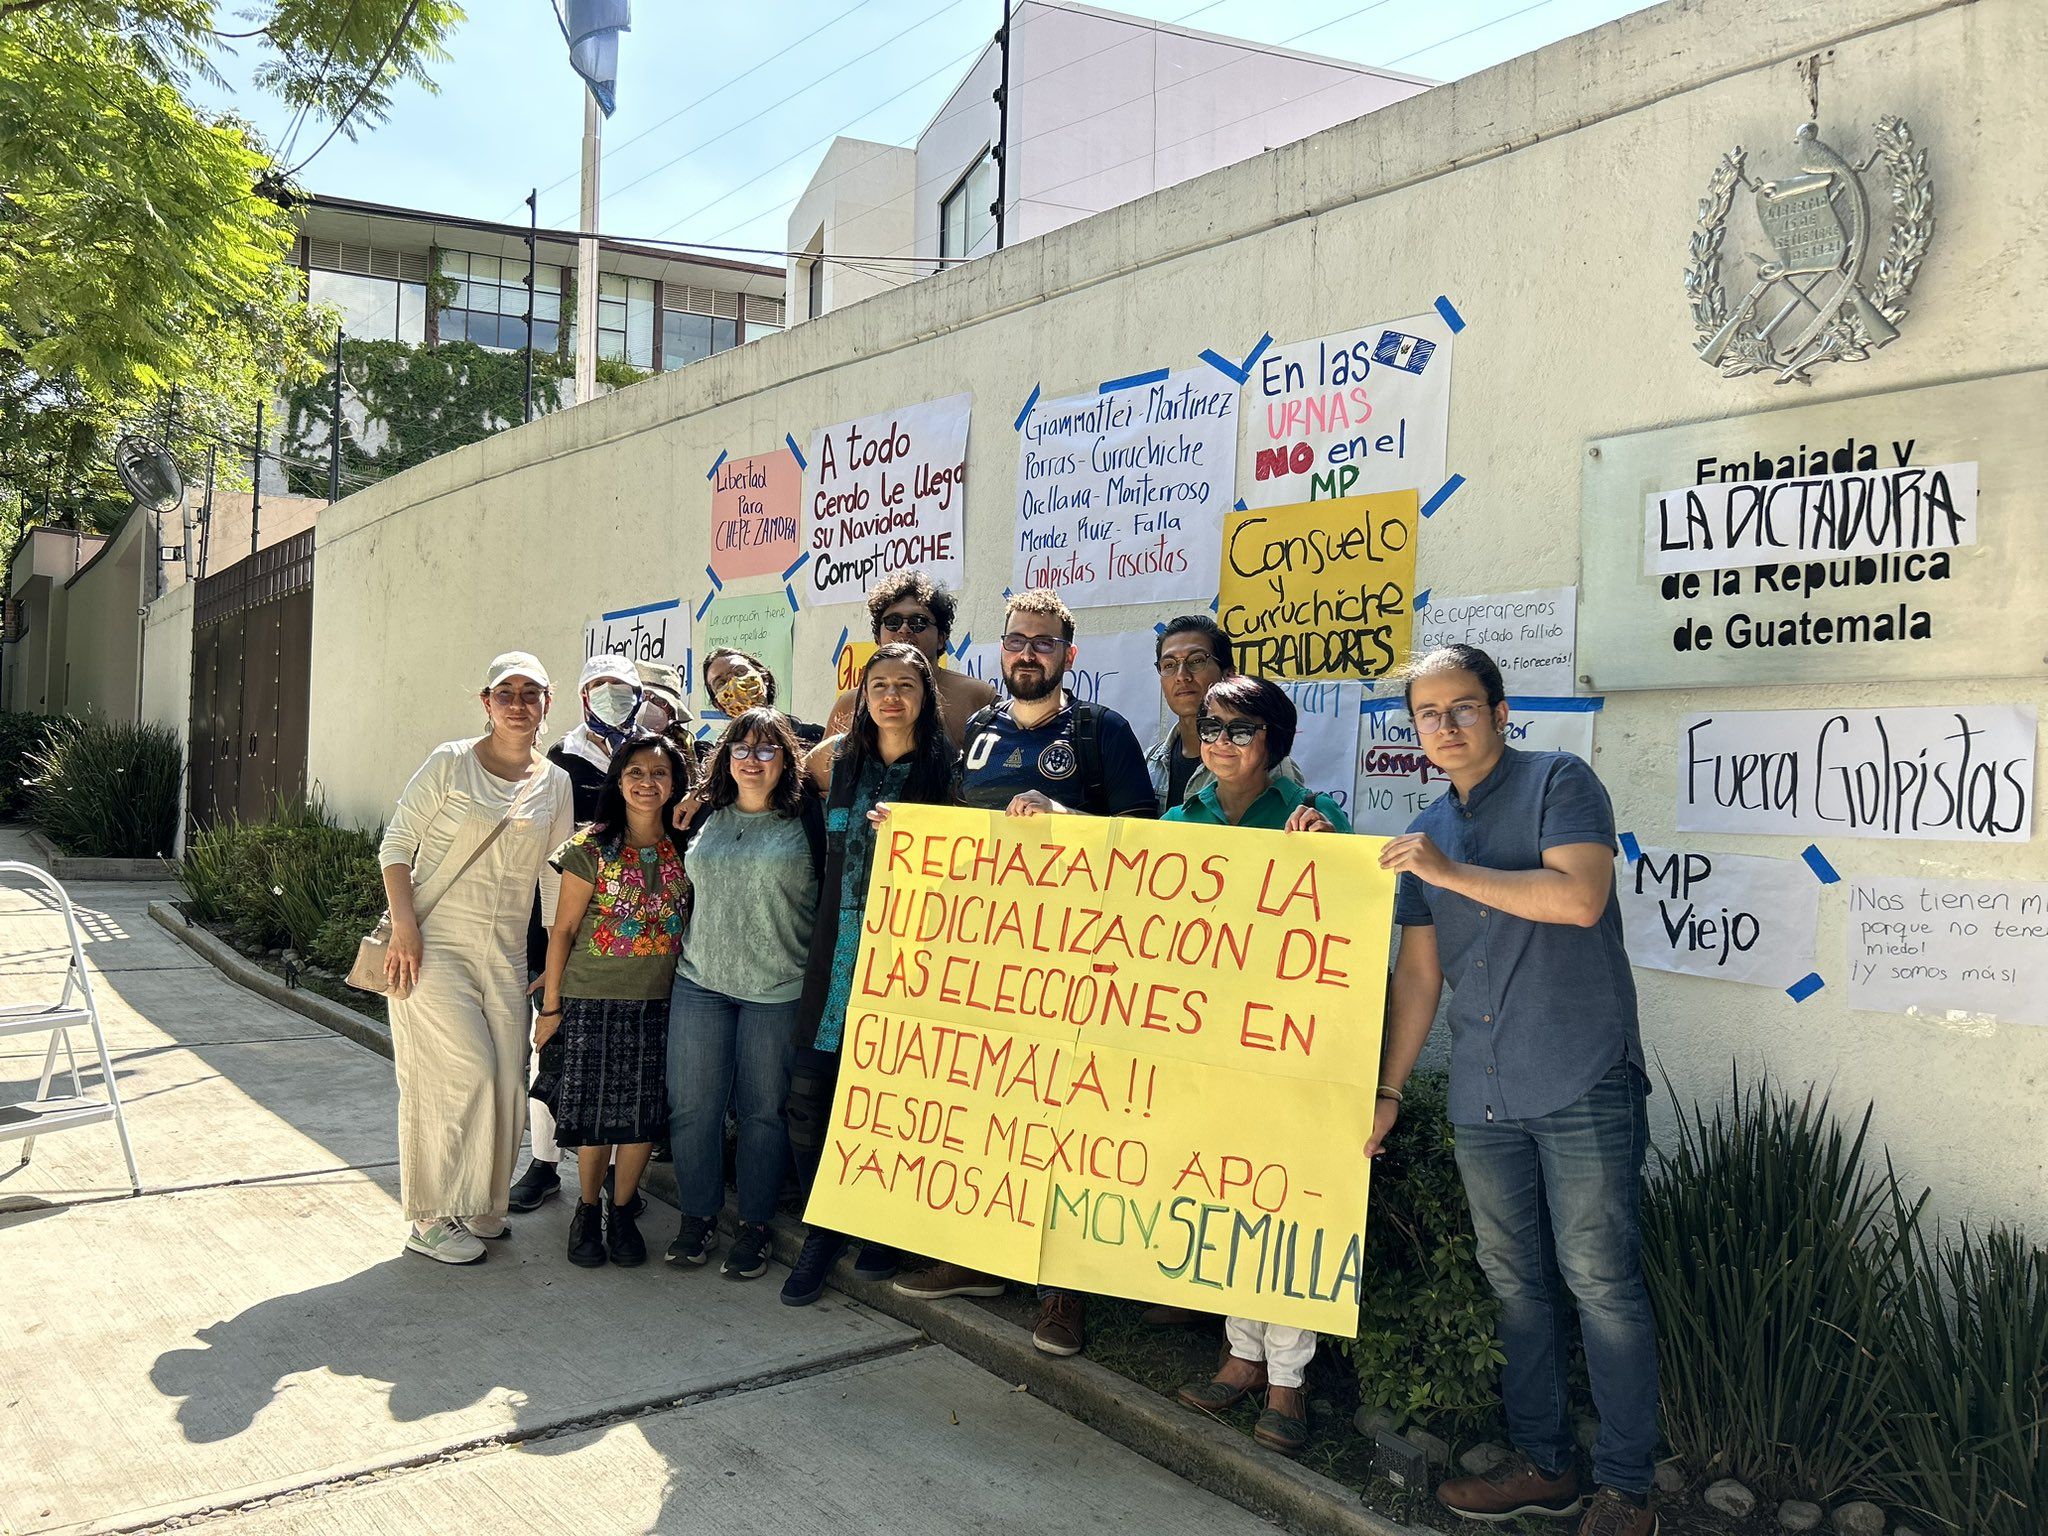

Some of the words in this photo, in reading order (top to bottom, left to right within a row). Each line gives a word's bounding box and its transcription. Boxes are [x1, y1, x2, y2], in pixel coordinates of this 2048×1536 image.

[1262, 355, 1304, 396] En
[1320, 340, 1371, 386] las
[1267, 387, 1373, 440] URNAS
[820, 433, 837, 485] A
[847, 421, 911, 471] todo
[1255, 442, 1315, 482] NO
[1328, 435, 1367, 464] en
[1375, 418, 1406, 459] el
[715, 460, 767, 492] Libertad
[814, 483, 869, 521] Cerdo
[881, 472, 905, 507] le
[914, 462, 966, 510] llega
[1310, 465, 1360, 502] MP
[738, 495, 764, 517] Para
[813, 527, 834, 549] su
[840, 503, 919, 548] Navidad,
[1134, 511, 1182, 535] Falla
[1660, 490, 1713, 551] LA
[1726, 469, 1966, 551] DICTADURA
[716, 518, 750, 551] CHEPE
[753, 516, 796, 546] ZAMORA
[1025, 551, 1096, 589] Golpistas
[1108, 534, 1188, 580] Fascistas
[1661, 573, 1700, 600] de
[1713, 569, 1740, 596] la
[1422, 601, 1556, 625] Recuperaremos
[1673, 617, 1712, 651] de
[1726, 604, 1932, 649] Guatemala
[1232, 625, 1395, 679] TRAIDORES
[1423, 631, 1455, 647] este
[1465, 628, 1514, 646] Estado
[1687, 718, 1798, 819] Fuera
[1814, 713, 2028, 837] Golpistas
[1368, 787, 1393, 811] NO
[888, 831, 1229, 903] RECHAZAMOS
[1256, 857, 1322, 922] LA
[1635, 853, 1712, 900] MP
[1920, 888, 2009, 912] tienen
[1659, 900, 1760, 966] Viejo
[1861, 922, 1933, 944] porque
[1950, 921, 1978, 936] no
[1994, 921, 2048, 938] tene
[1867, 942, 1925, 956] miedo!
[1276, 928, 1351, 988] DE
[1890, 965, 1948, 980] somos
[861, 947, 931, 999] LAS
[1240, 1002, 1316, 1056] EN
[844, 1085, 968, 1153] DESDE
[1050, 1184, 1161, 1249] MOV.
[1157, 1196, 1361, 1304] SEMILLA
